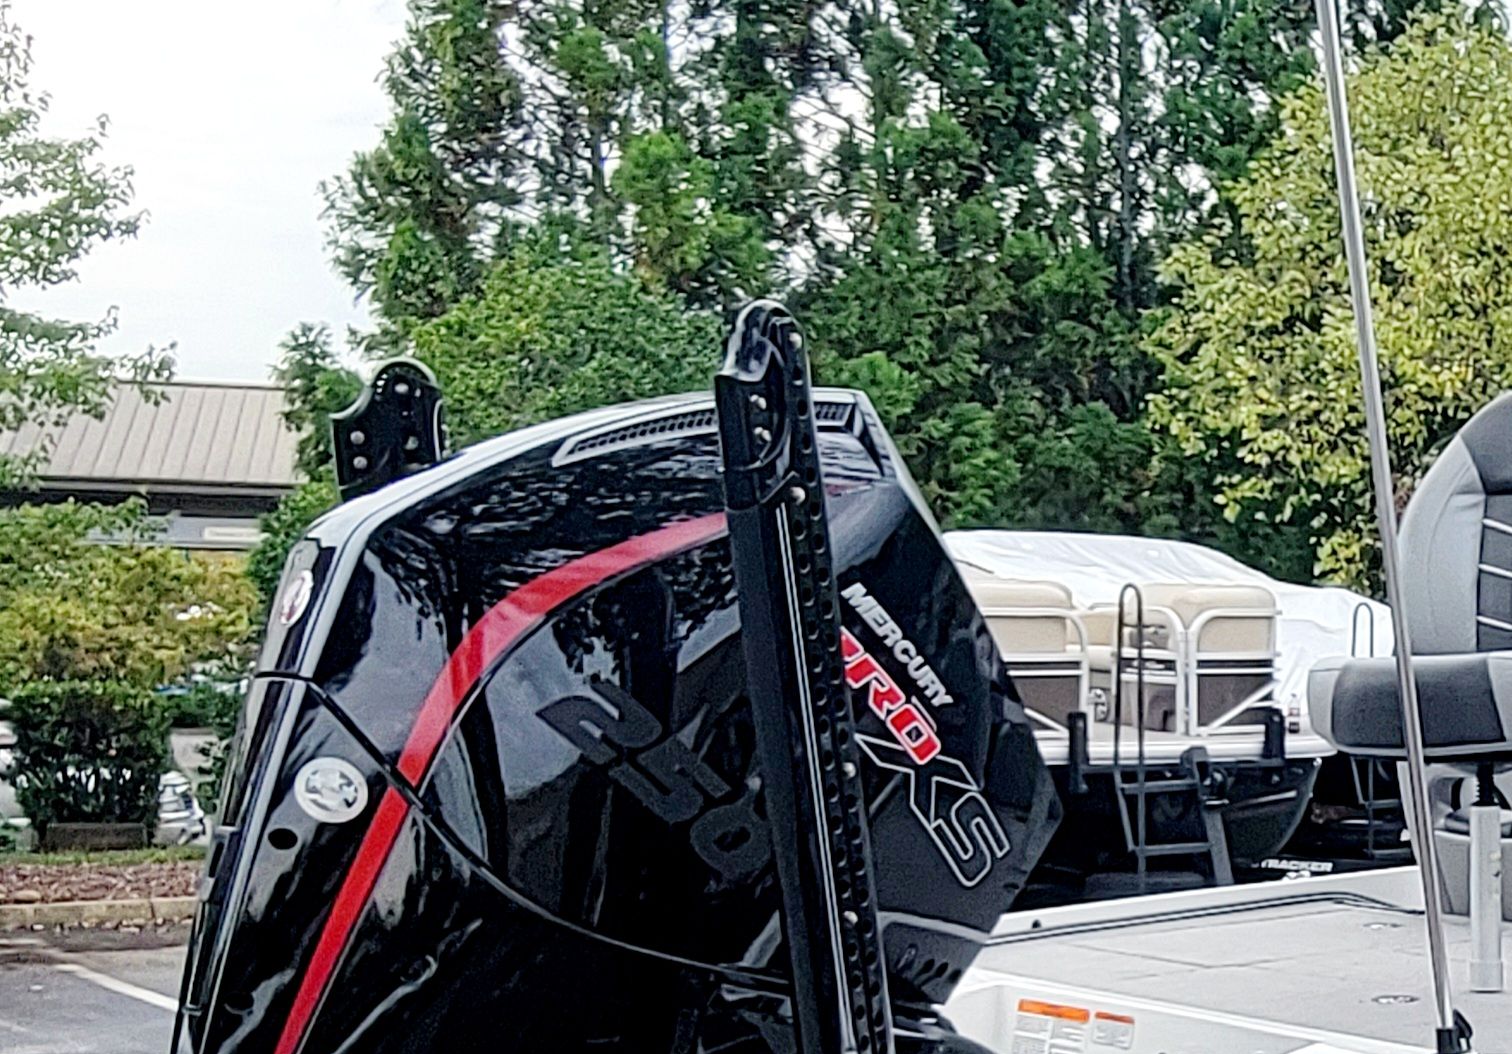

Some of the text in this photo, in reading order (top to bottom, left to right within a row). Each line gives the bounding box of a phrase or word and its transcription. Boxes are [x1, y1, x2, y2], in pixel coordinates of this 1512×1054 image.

[841, 582, 953, 707] MERCURY
[536, 681, 771, 882] 250
[854, 731, 1011, 887] XS
